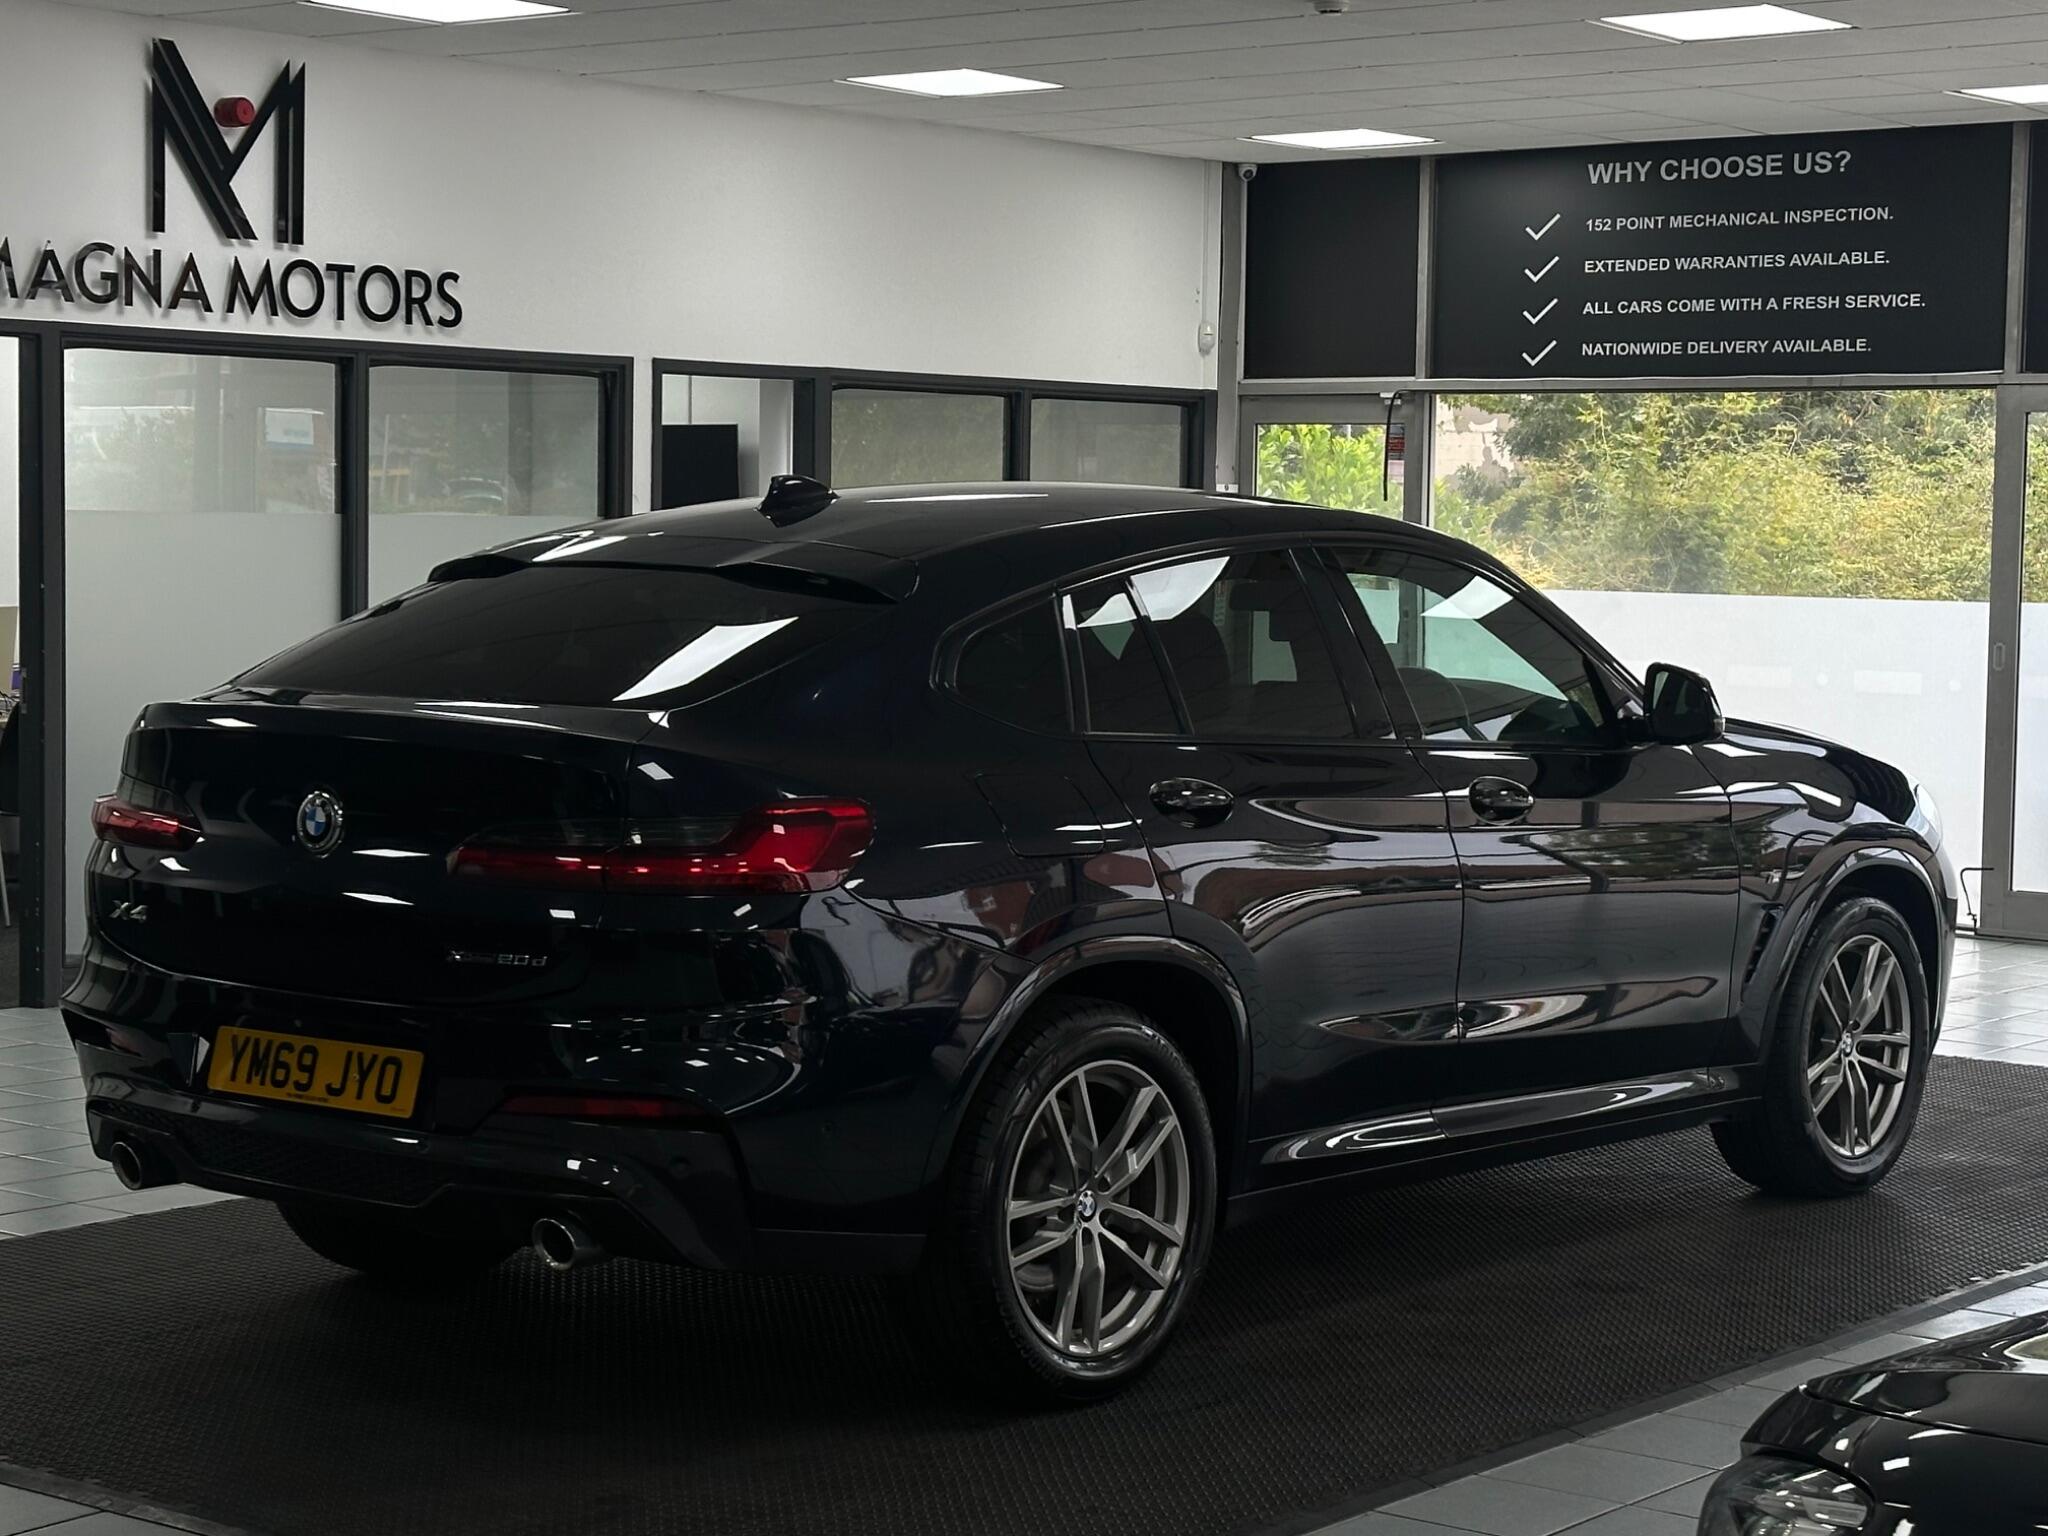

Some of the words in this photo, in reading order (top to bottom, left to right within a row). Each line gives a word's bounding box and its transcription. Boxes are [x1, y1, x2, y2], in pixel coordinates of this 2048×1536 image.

[1587, 161, 1652, 184] WHY
[1660, 154, 1783, 181] CHOOSE
[1793, 150, 1851, 174] US?
[1586, 218, 1612, 232] 152
[1616, 215, 1665, 230] POINT
[1669, 211, 1780, 229] MECHANICAL
[1784, 206, 1894, 224] INSPECTION.
[1584, 258, 1670, 273] EXTENDED
[1674, 254, 1785, 270] WARRANTIES
[1789, 251, 1890, 267] AVAILABLE.
[226, 255, 463, 329] MOTORS
[1582, 301, 1613, 315] ALL
[1617, 300, 1662, 314] CARS
[1667, 299, 1715, 313] COME
[1720, 298, 1762, 311] WITH
[1766, 297, 1778, 310] A
[1782, 296, 1840, 310] FRESH
[1844, 293, 1926, 308] SERVICE.
[1582, 341, 1683, 356] NATIONWIDE
[1687, 340, 1769, 354] DELIVERY
[1772, 338, 1871, 353] AVAILABLE.
[109, 900, 148, 923] X4
[229, 1033, 319, 1093] YM69
[325, 1050, 403, 1105] JYO
